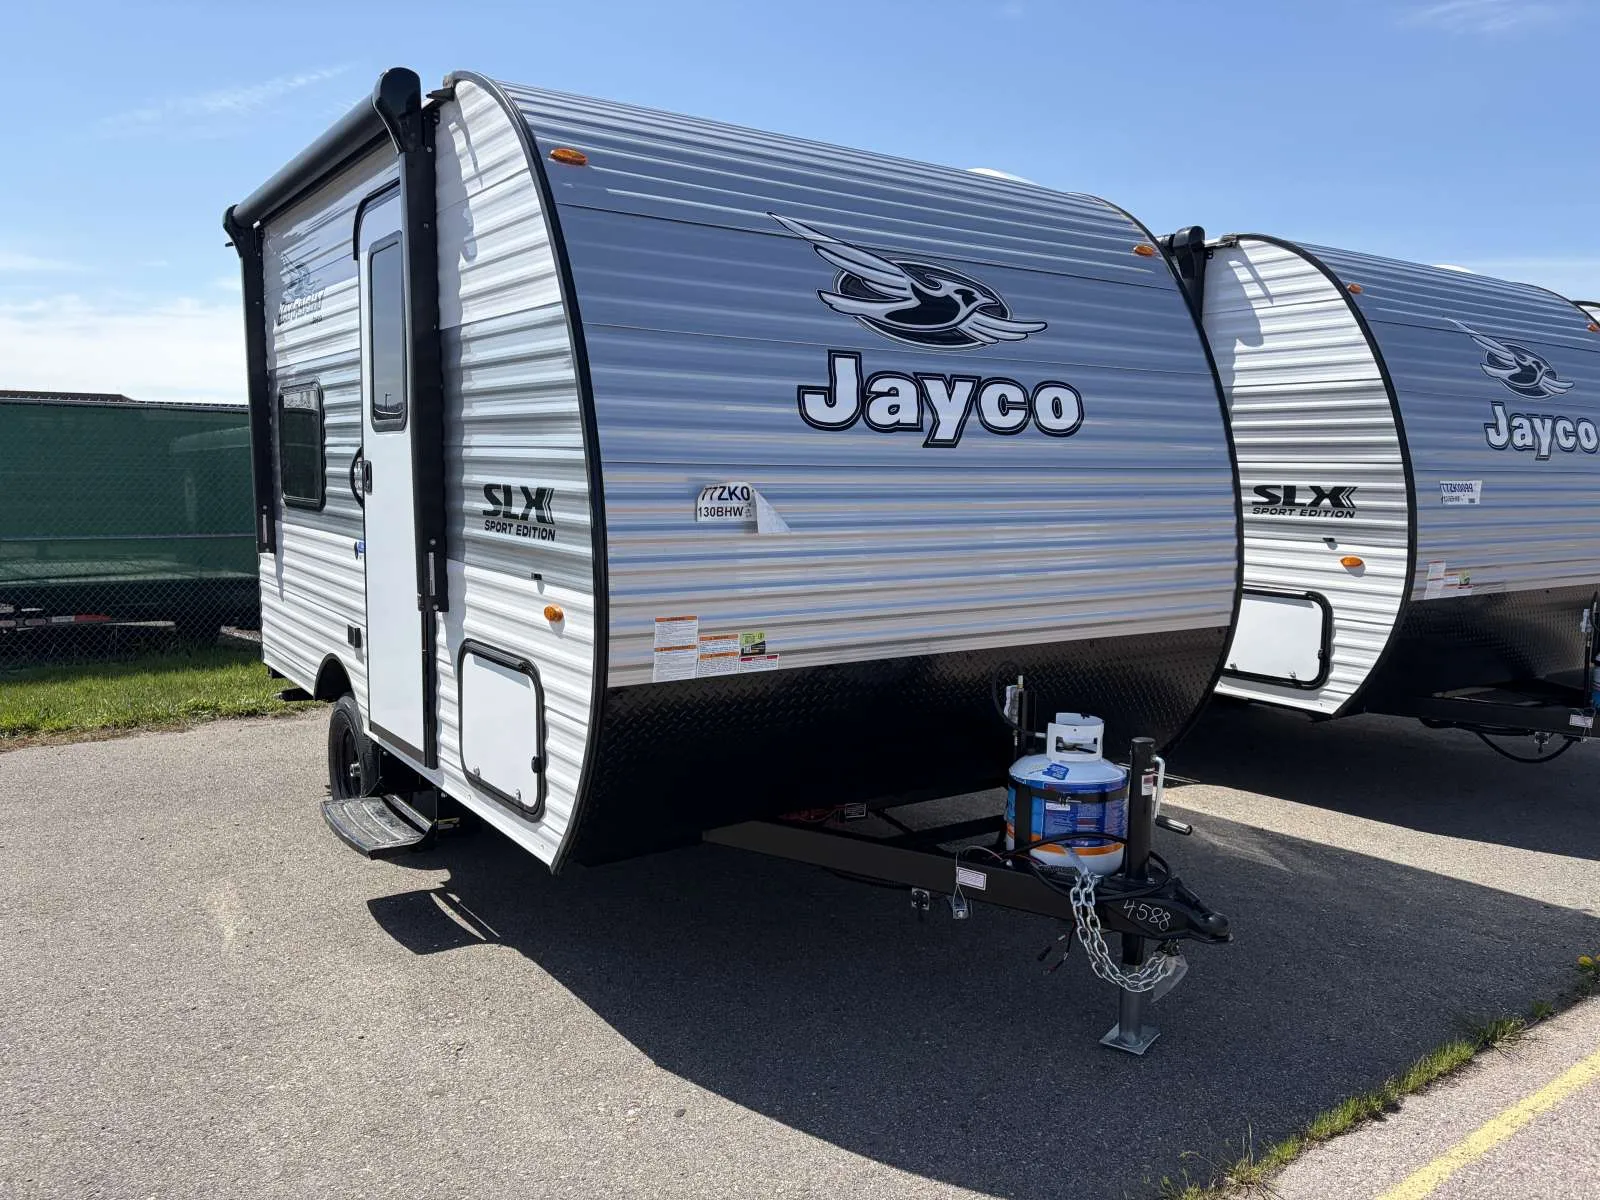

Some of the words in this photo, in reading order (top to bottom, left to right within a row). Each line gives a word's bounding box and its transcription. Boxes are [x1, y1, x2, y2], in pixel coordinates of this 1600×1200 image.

[797, 349, 1085, 448] Jayco
[1484, 401, 1600, 460] Jayco
[482, 484, 555, 524] SLX
[1251, 484, 1358, 508] SLX
[698, 506, 744, 517] 130BHW
[1252, 507, 1296, 516] SPORT
[1300, 509, 1356, 519] EDITION
[484, 519, 513, 534] SPORT
[515, 524, 556, 541] EDITION
[1123, 899, 1171, 931] 4588
